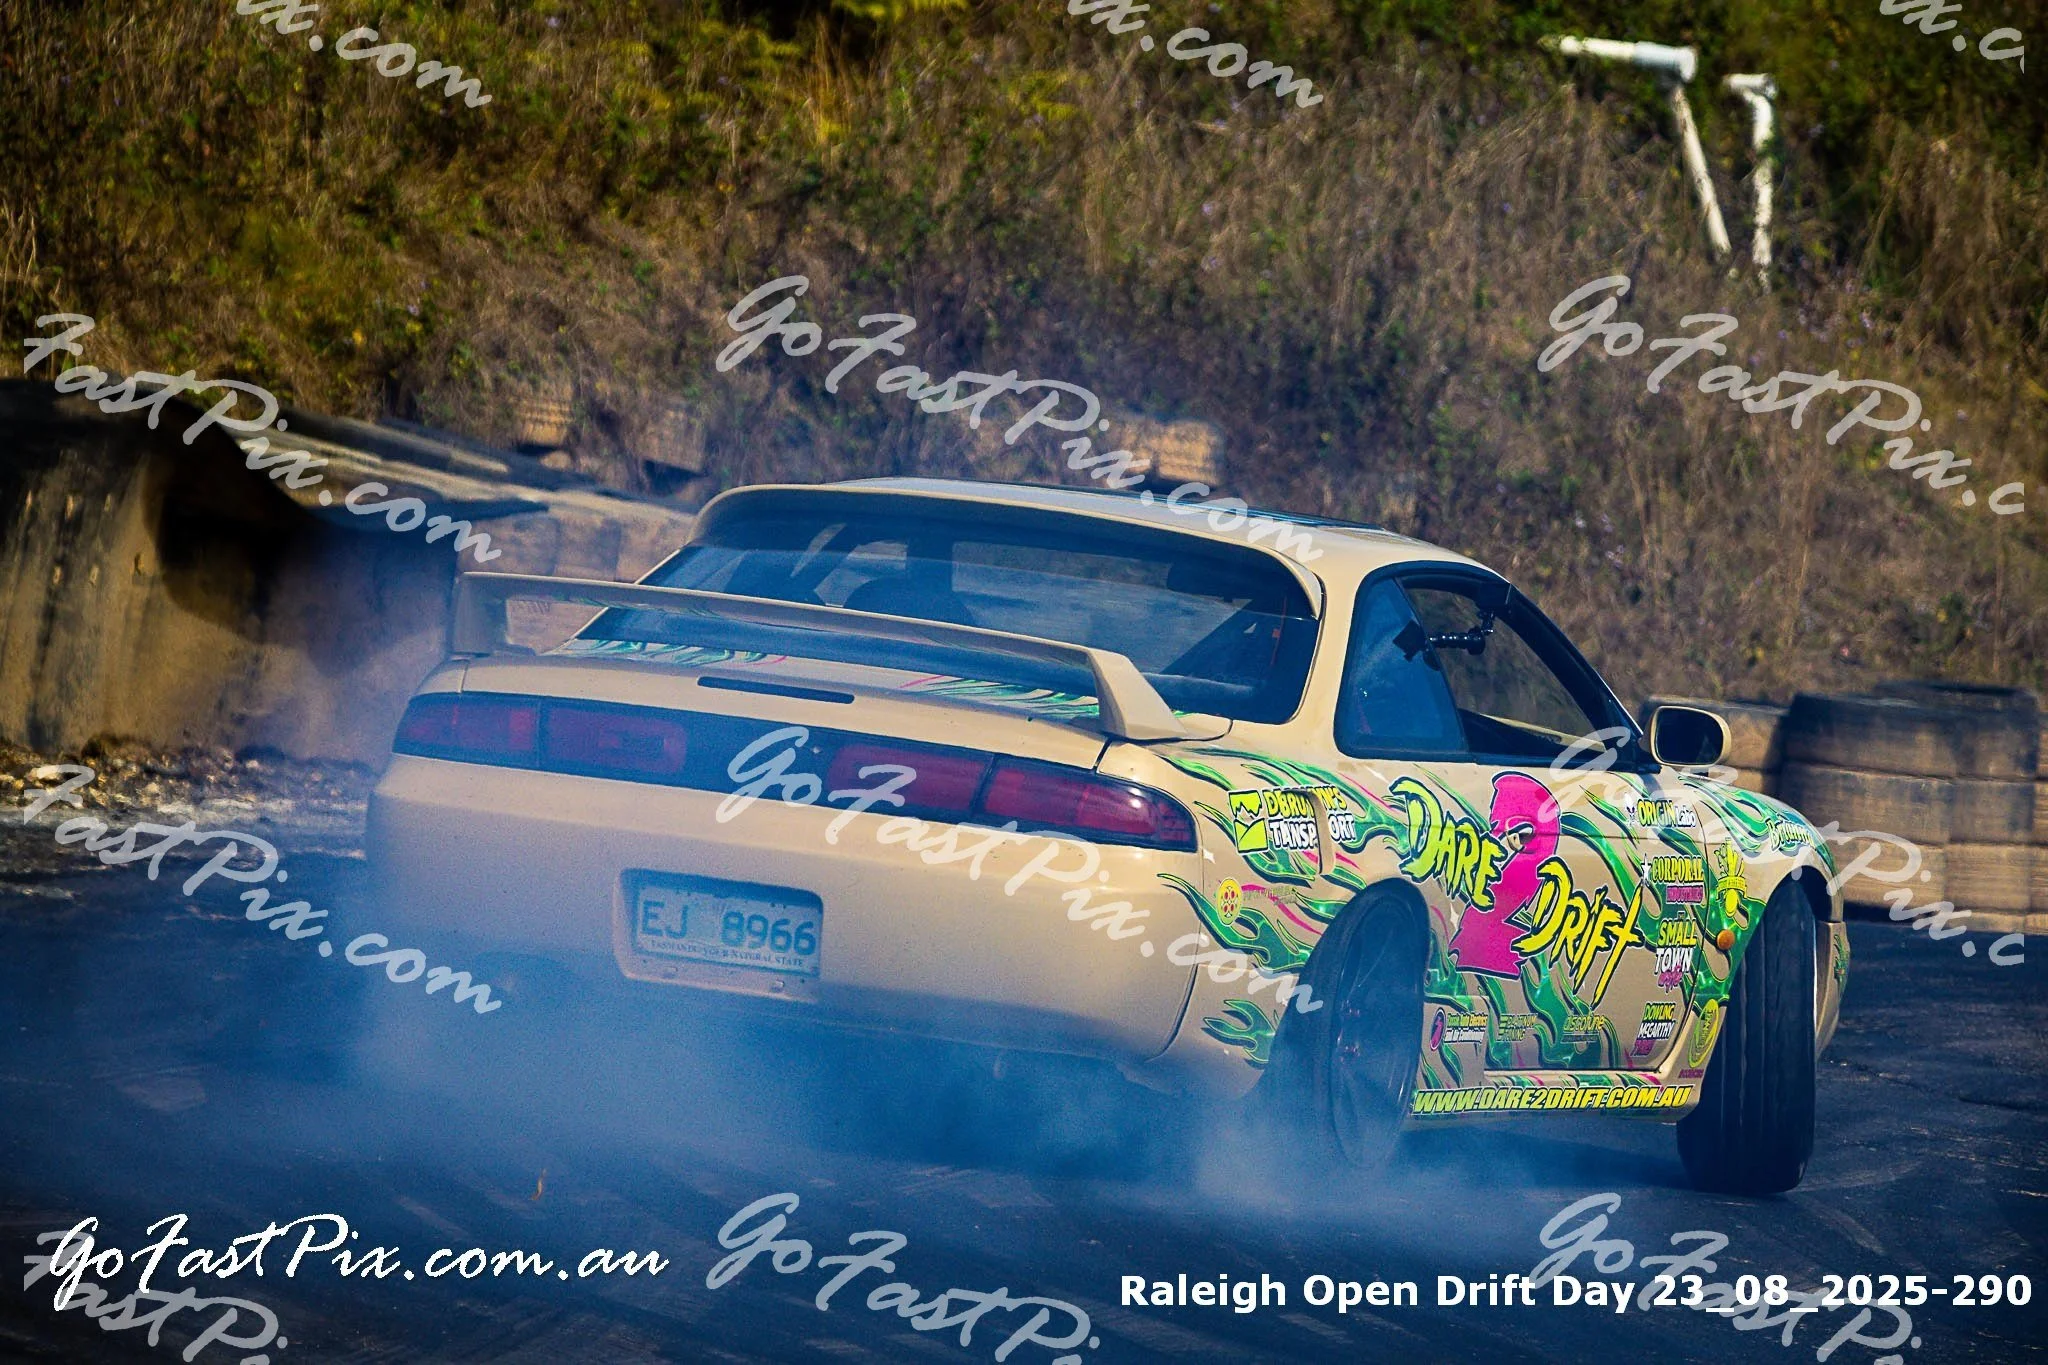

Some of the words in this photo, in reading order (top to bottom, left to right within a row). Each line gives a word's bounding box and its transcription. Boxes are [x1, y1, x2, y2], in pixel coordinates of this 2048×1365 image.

[1637, 799, 1676, 828] ORIGIN
[1389, 776, 1509, 912] DARE
[1651, 856, 1705, 883] CORPORAL
[641, 900, 688, 939] EJ
[721, 911, 817, 956] 8966
[1656, 918, 1698, 947] SMALL
[1653, 946, 1693, 976] TOWN
[1411, 1084, 1696, 1116] WWW.DARE2DRIFT.COM.AU
